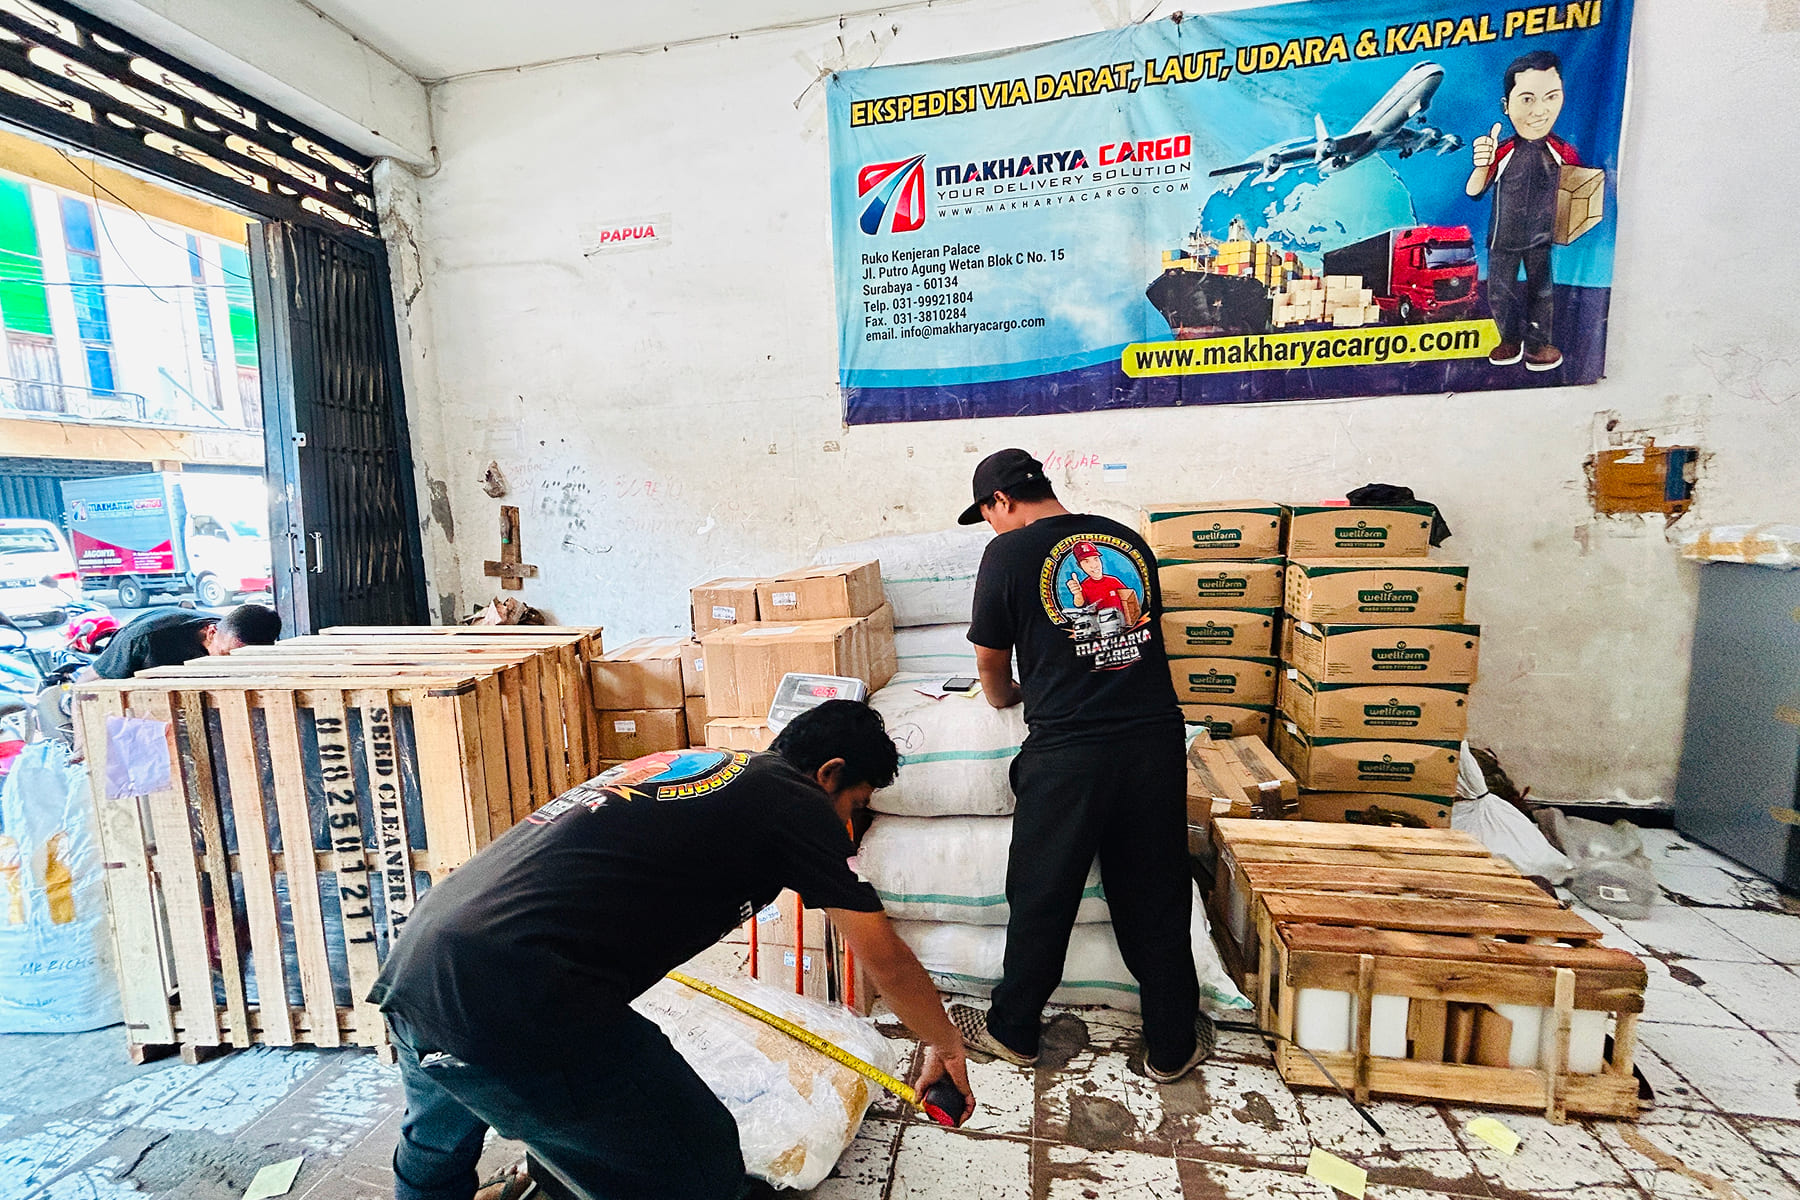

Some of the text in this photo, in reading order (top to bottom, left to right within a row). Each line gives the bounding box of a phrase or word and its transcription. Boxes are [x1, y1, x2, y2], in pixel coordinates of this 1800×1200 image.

[851, 0, 1601, 127] EKSPEDISI VIA DARAT, LAUT, UDARA & KAPAL PELNI
[937, 135, 1191, 186] MAKHARYA CARGO
[937, 161, 1191, 200] YOUR DELIVERY SOLUTION
[938, 183, 1190, 217] WWW.MAKHARYACARGO.COM
[600, 225, 655, 243] PAPUA
[861, 243, 980, 265] Ruko Kenjeran Palace
[862, 249, 1064, 280] Jl. Putro Agung Wetan Blok C No. 15
[863, 281, 912, 296] Surabaya
[923, 276, 958, 290] 60134
[864, 291, 973, 315] Telp. 031-99921804
[865, 307, 966, 327] Fax. 031-3810284
[866, 317, 1045, 341] email. info@makharyacargo.com
[1135, 327, 1480, 370] www.makharyacargo.com
[1196, 532, 1237, 540] wellfarm
[1339, 530, 1382, 538] wellfarm
[1202, 579, 1242, 588] wellfarm
[1363, 592, 1413, 601] wellfarm
[1075, 628, 1152, 657] MAKHARYA
[1095, 645, 1141, 666] CARGO
[1376, 651, 1425, 660] wellfarm
[1369, 707, 1416, 716] wellfarm
[1363, 763, 1411, 772] wellfarm
[657, 765, 744, 801] BARANG
[370, 707, 409, 939] SEED CLEANER A
